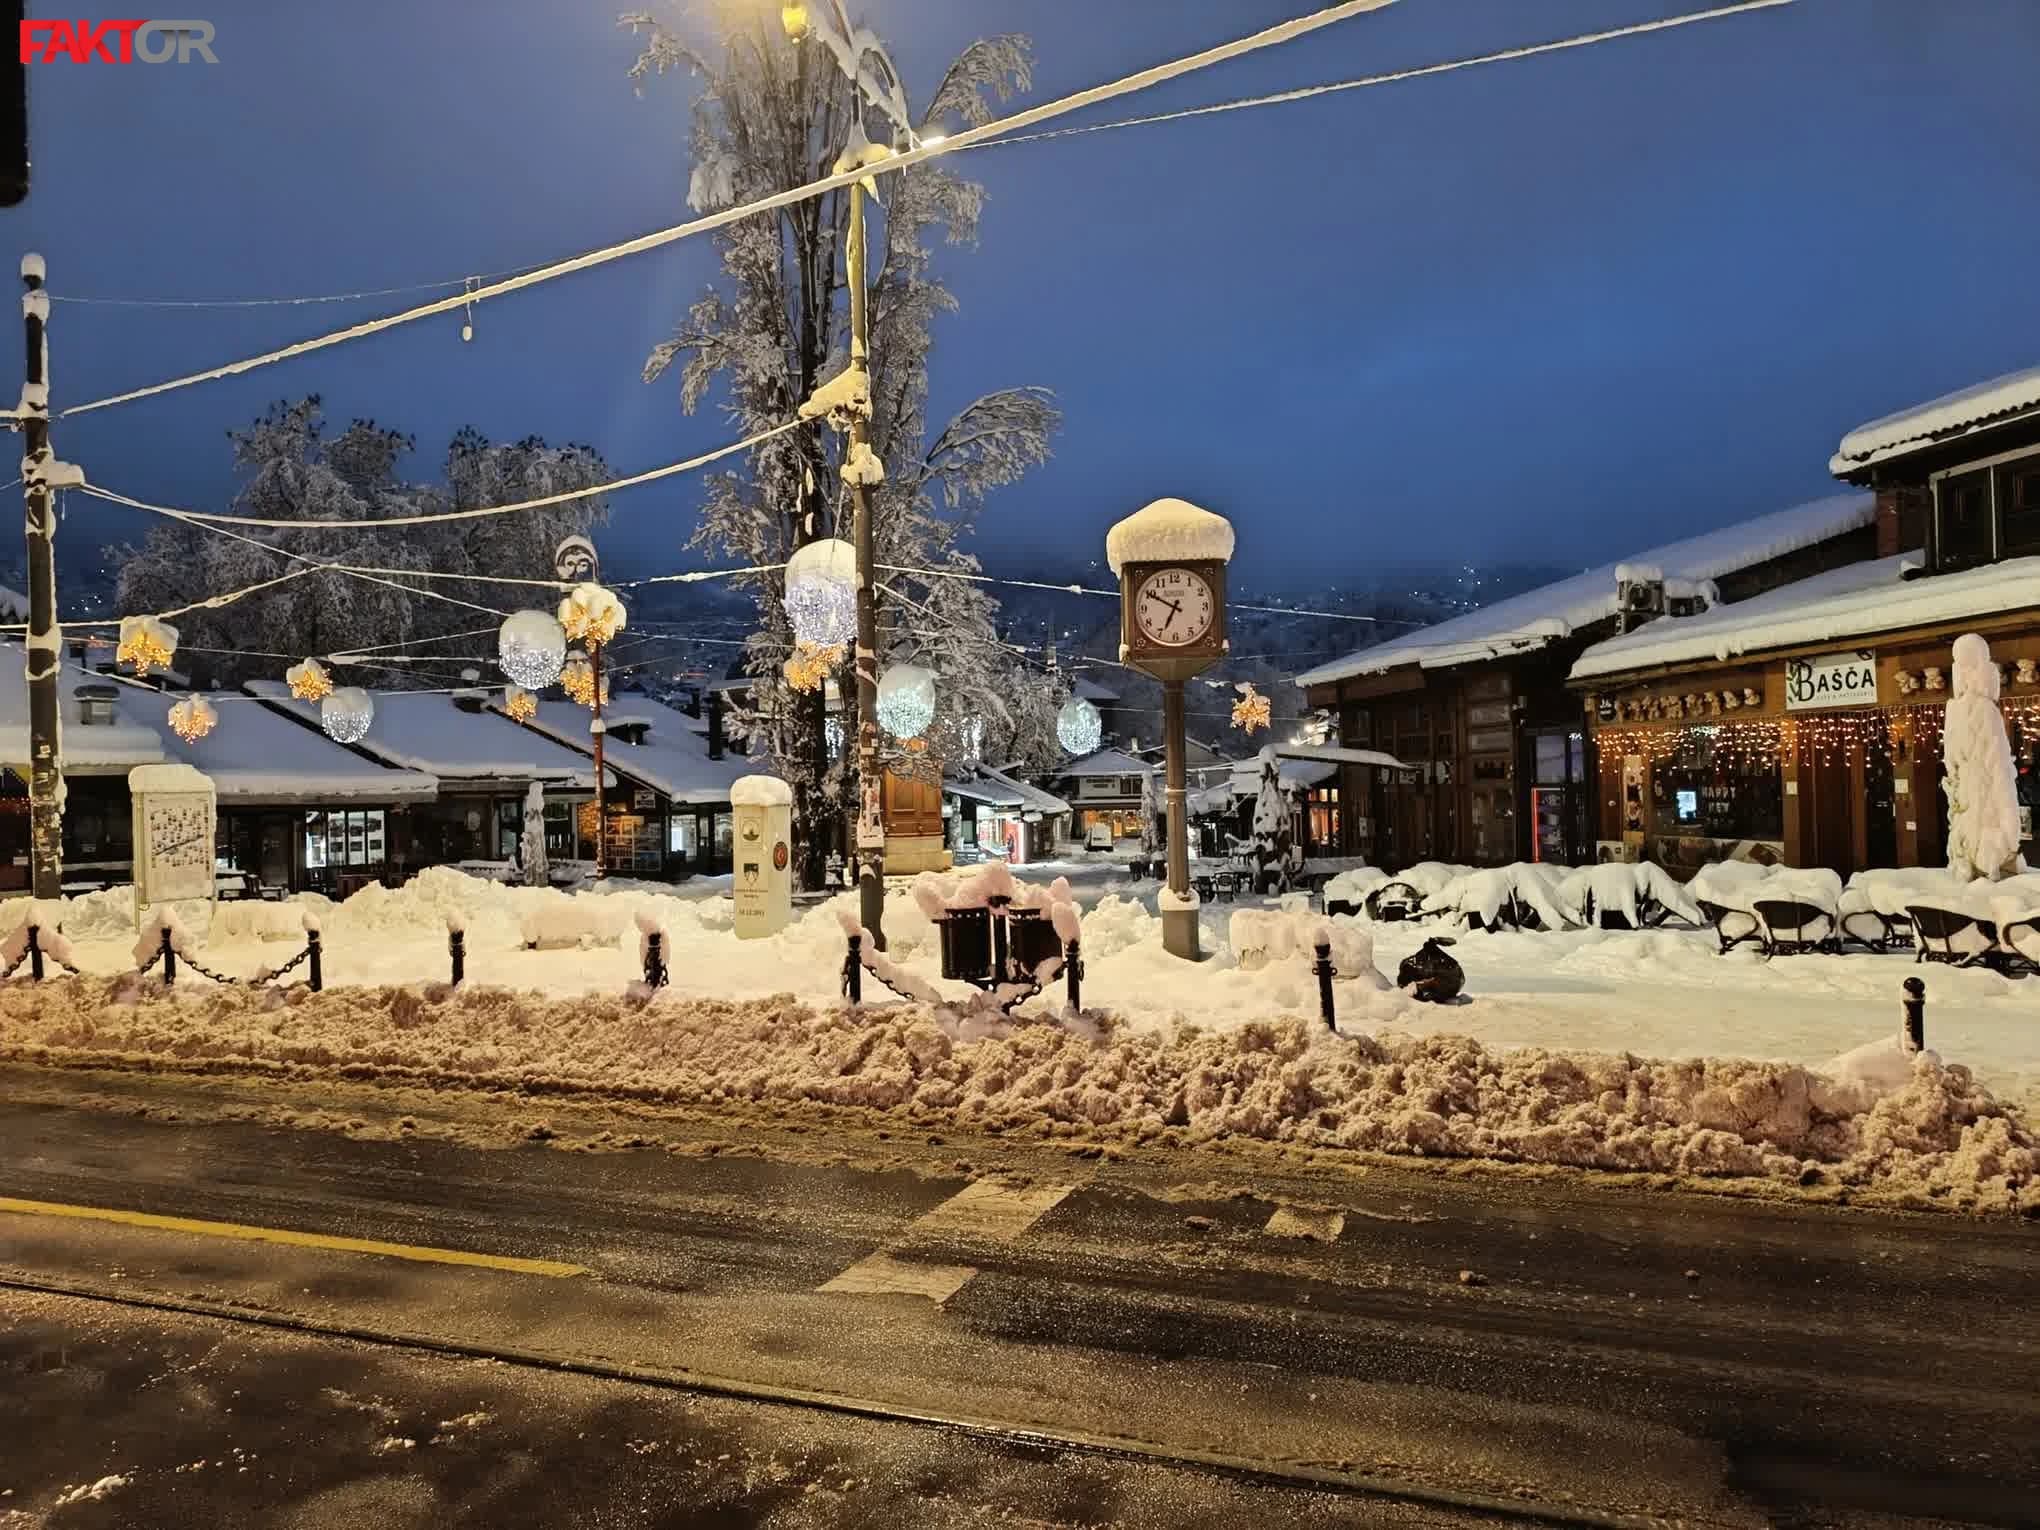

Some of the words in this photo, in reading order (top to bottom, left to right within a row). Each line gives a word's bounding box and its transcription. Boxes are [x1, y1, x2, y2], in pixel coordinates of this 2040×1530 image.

[1156, 578, 1165, 588] 11
[1170, 573, 1180, 583] 12
[1187, 576, 1191, 587] 1
[1197, 588, 1204, 596] 2
[1141, 604, 1147, 614] 9
[1202, 602, 1209, 612] 3
[1145, 618, 1152, 627] 8
[1157, 628, 1163, 638] 7
[1172, 632, 1179, 641] 6
[1187, 627, 1194, 637] 5
[1796, 662, 1875, 702] BAŠČA
